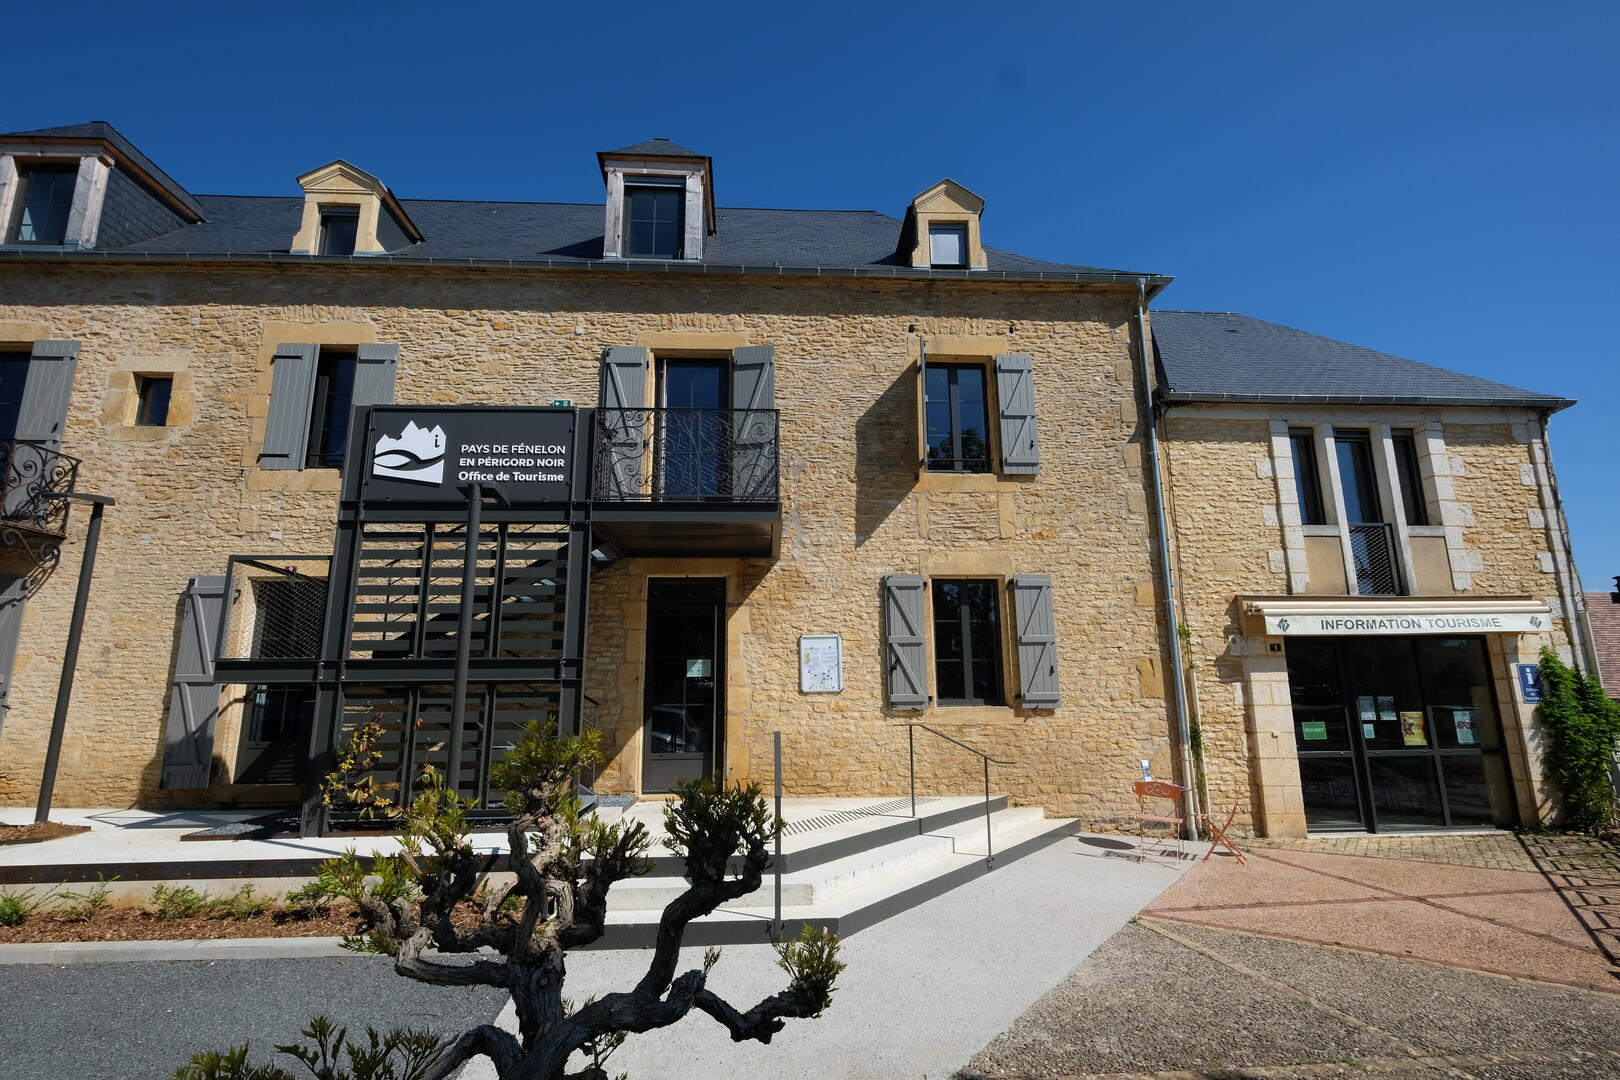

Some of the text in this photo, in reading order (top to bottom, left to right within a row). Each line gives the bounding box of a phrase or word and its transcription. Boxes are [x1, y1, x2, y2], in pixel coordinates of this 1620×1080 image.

[461, 442, 566, 455] PAYS DE FÉNELON
[459, 456, 565, 467] EN PÉRIGORD NOIR
[458, 471, 565, 482] Office de Tourisme
[1320, 617, 1502, 630] INFORMATION TOURISME
